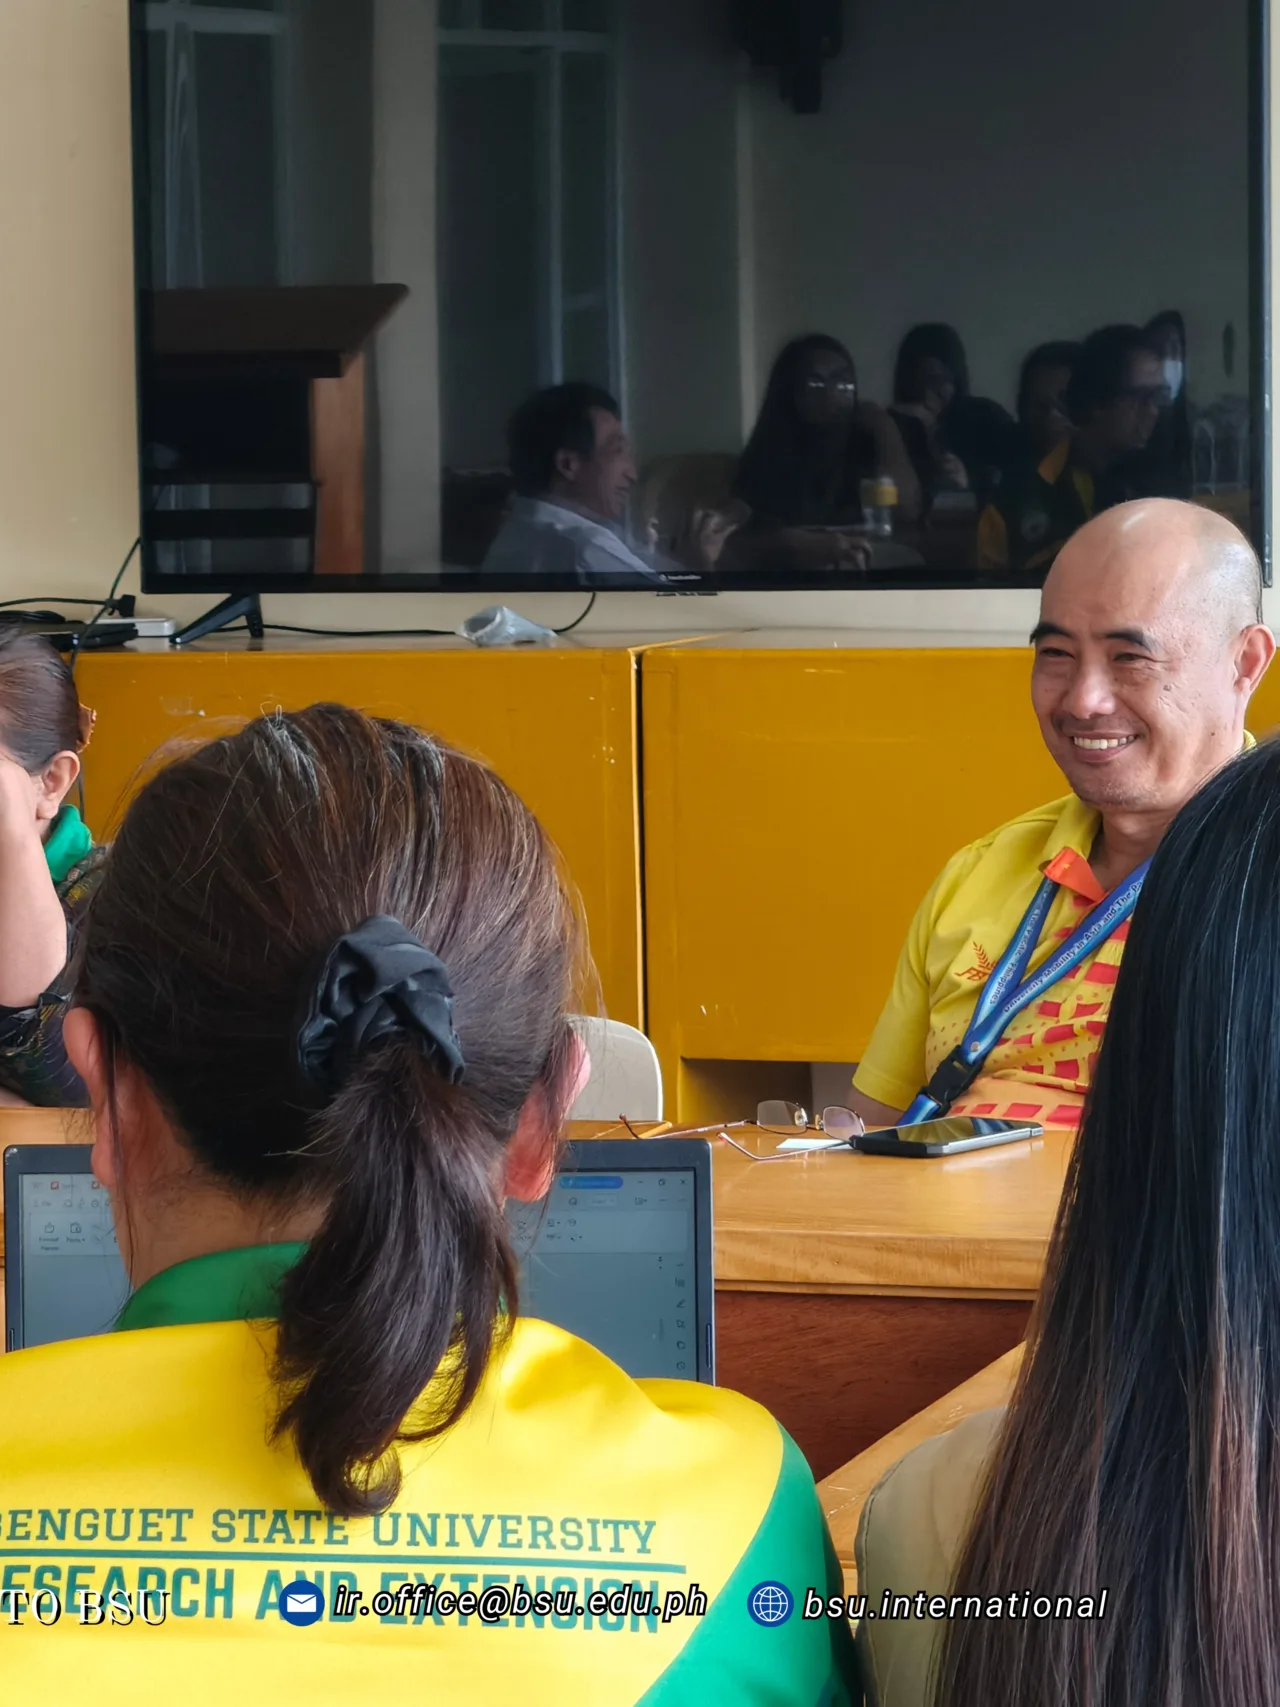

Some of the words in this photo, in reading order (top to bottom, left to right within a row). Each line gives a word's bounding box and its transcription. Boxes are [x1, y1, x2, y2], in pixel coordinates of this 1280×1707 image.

[1003, 978, 1045, 1013] University
[1043, 950, 1076, 978] Mobility
[1075, 940, 1085, 950] in
[1083, 922, 1102, 941] Asia
[1103, 907, 1117, 923] and
[1115, 892, 1131, 908] The
[211, 1509, 350, 1545] STATE
[373, 1512, 657, 1554] UNIVERSITY
[255, 1569, 358, 1622] AD
